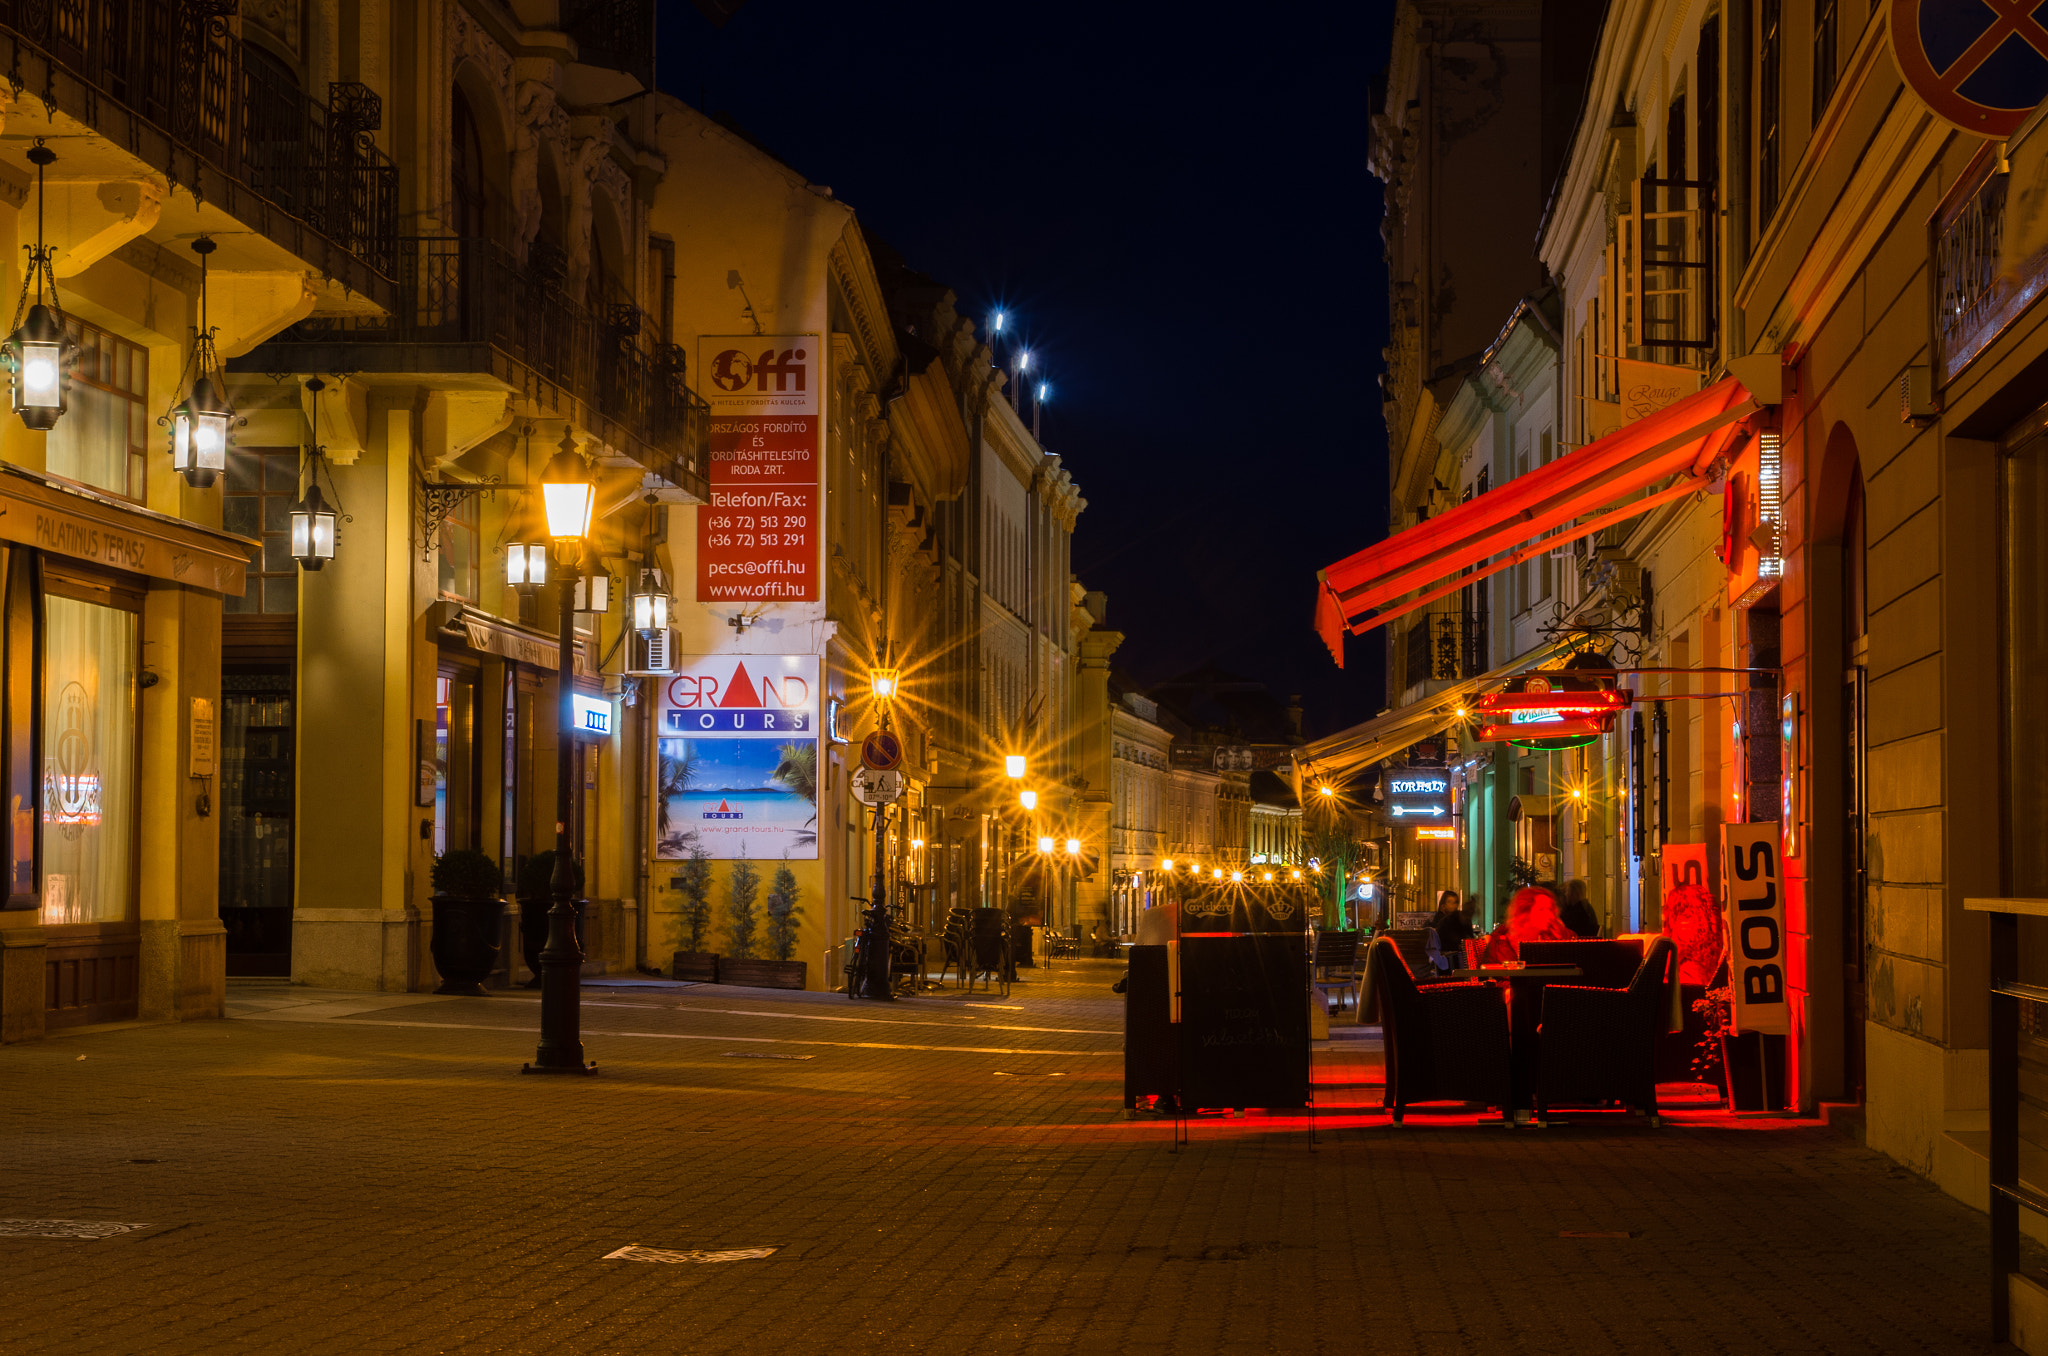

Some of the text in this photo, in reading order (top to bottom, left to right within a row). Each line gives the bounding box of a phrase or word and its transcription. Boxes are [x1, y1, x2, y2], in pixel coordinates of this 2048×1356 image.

[1627, 385, 1681, 407] Rouge
[707, 420, 807, 433] ORSZÁGOS FORDÍTÓ
[752, 435, 765, 447] ÉS
[731, 465, 786, 475] IRODA ZRT.
[710, 492, 807, 508] Telefon/Fax:
[708, 516, 806, 530] (+36 72) 513 290
[36, 514, 98, 557] PALATINUS
[103, 533, 145, 569] TERASZ
[708, 534, 805, 548] (+36 72) 513 291
[709, 560, 806, 577] pecs@offi.hu
[710, 582, 805, 597] www.offi.hu
[667, 660, 809, 708] GRAND
[672, 713, 804, 730] TOURS
[702, 798, 744, 812] GRAND
[701, 825, 785, 835] www.grand-tours.hu
[1183, 898, 1234, 915] Carlsberg
[1733, 840, 1784, 1005] BOLS
